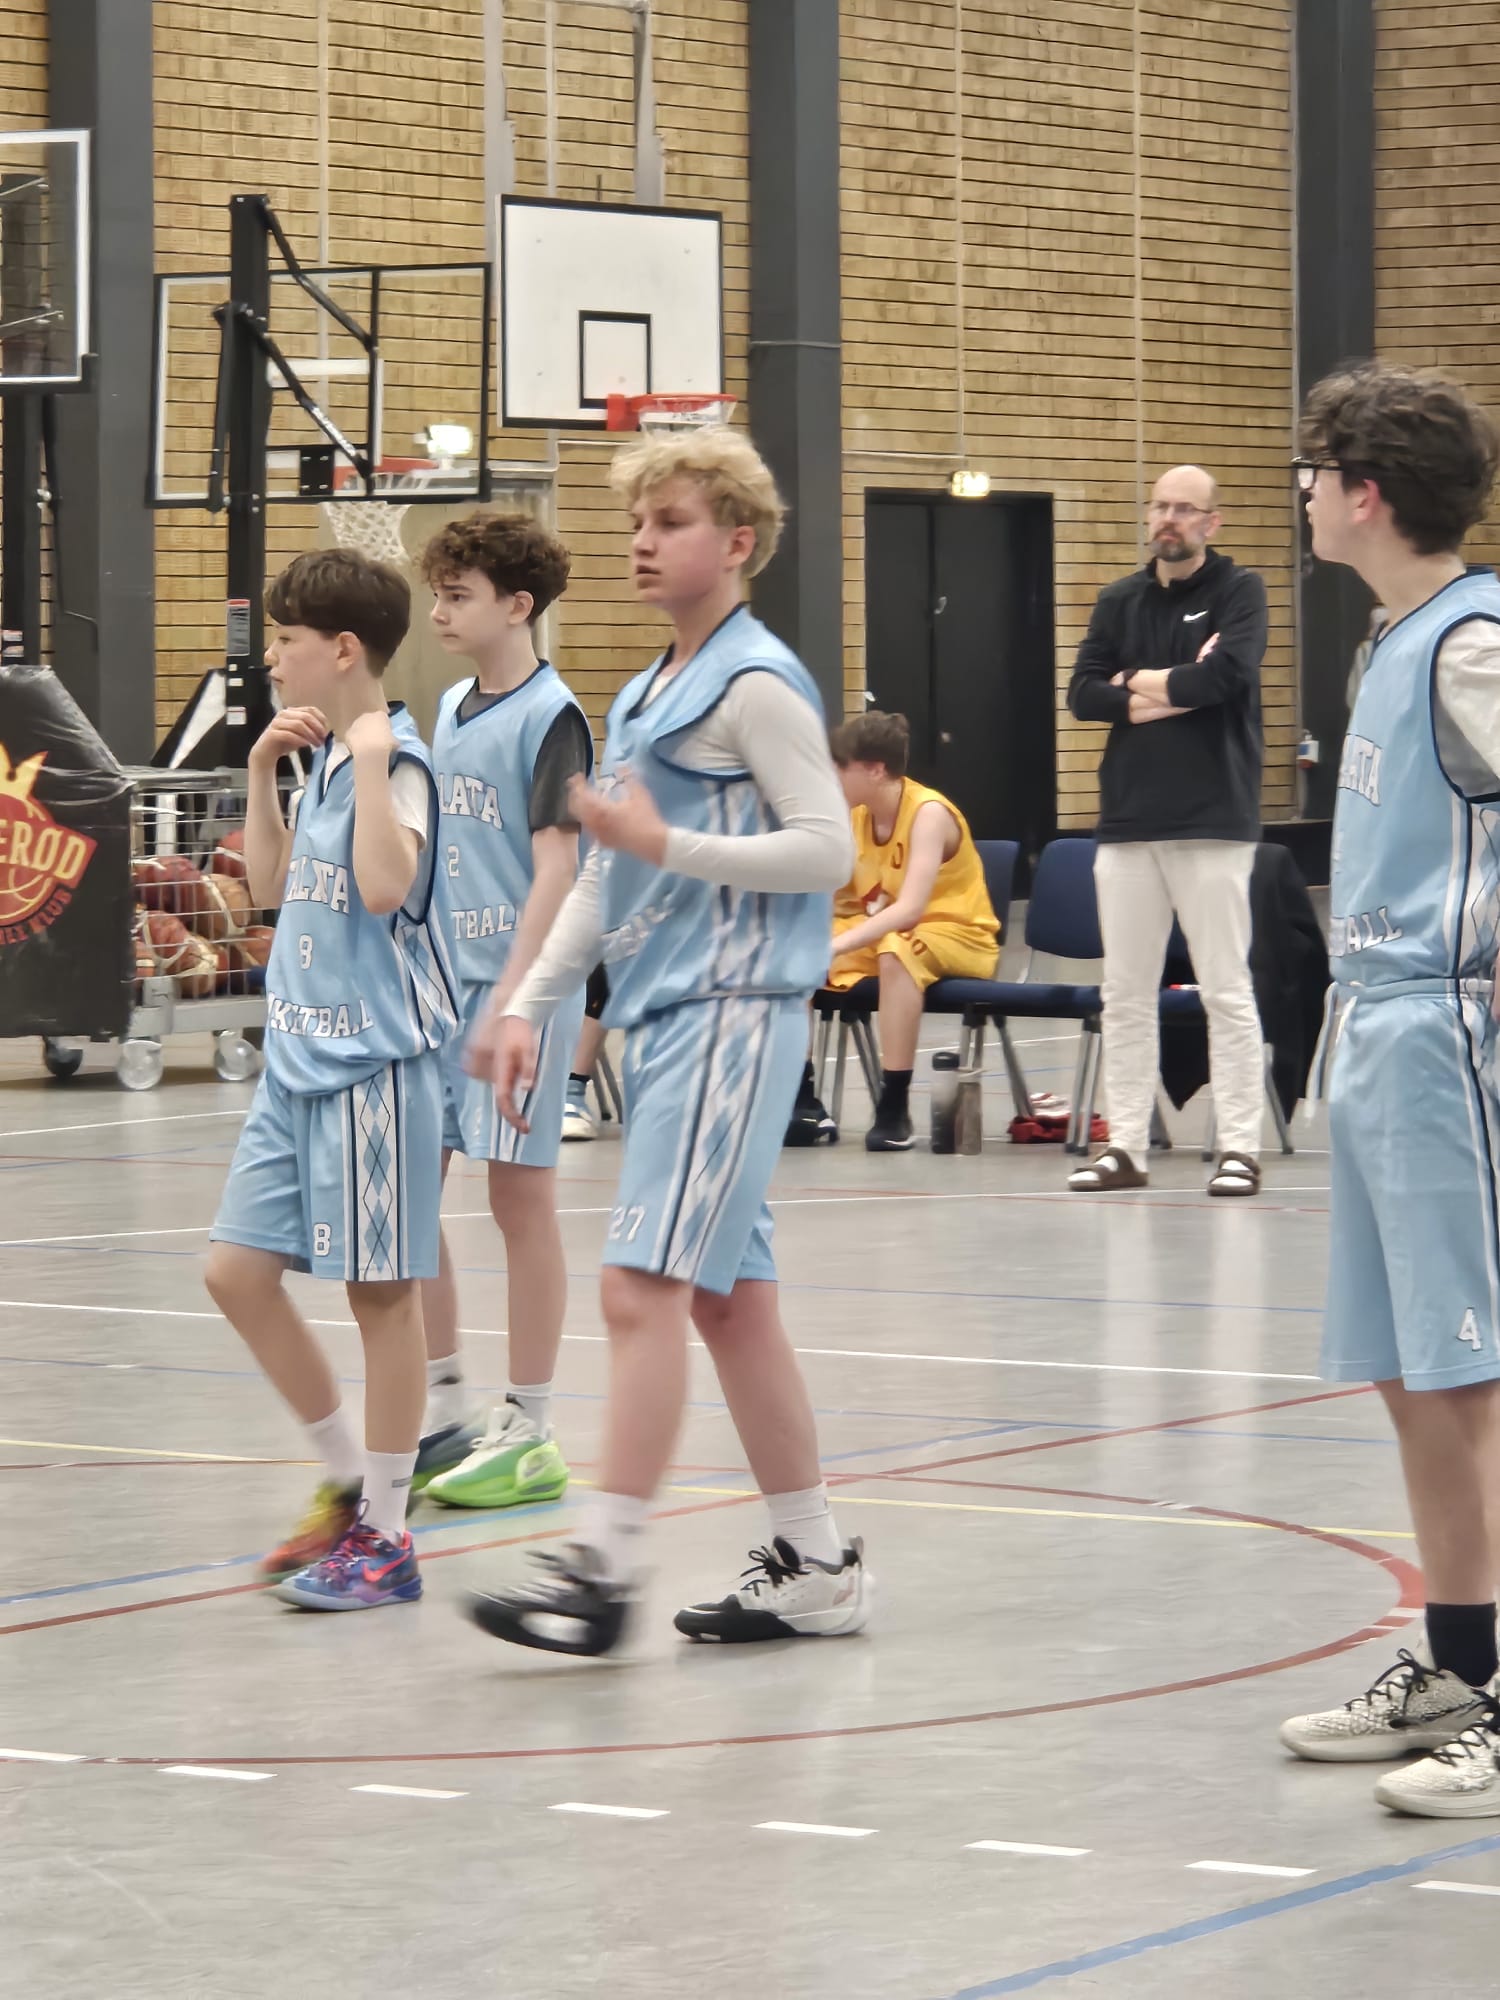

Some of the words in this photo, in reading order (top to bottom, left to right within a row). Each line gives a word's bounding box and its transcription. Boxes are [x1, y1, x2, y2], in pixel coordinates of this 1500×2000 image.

[447, 845, 460, 877] 2
[313, 1223, 332, 1257] 8
[609, 1206, 645, 1241] 27
[1457, 1307, 1482, 1351] 4
